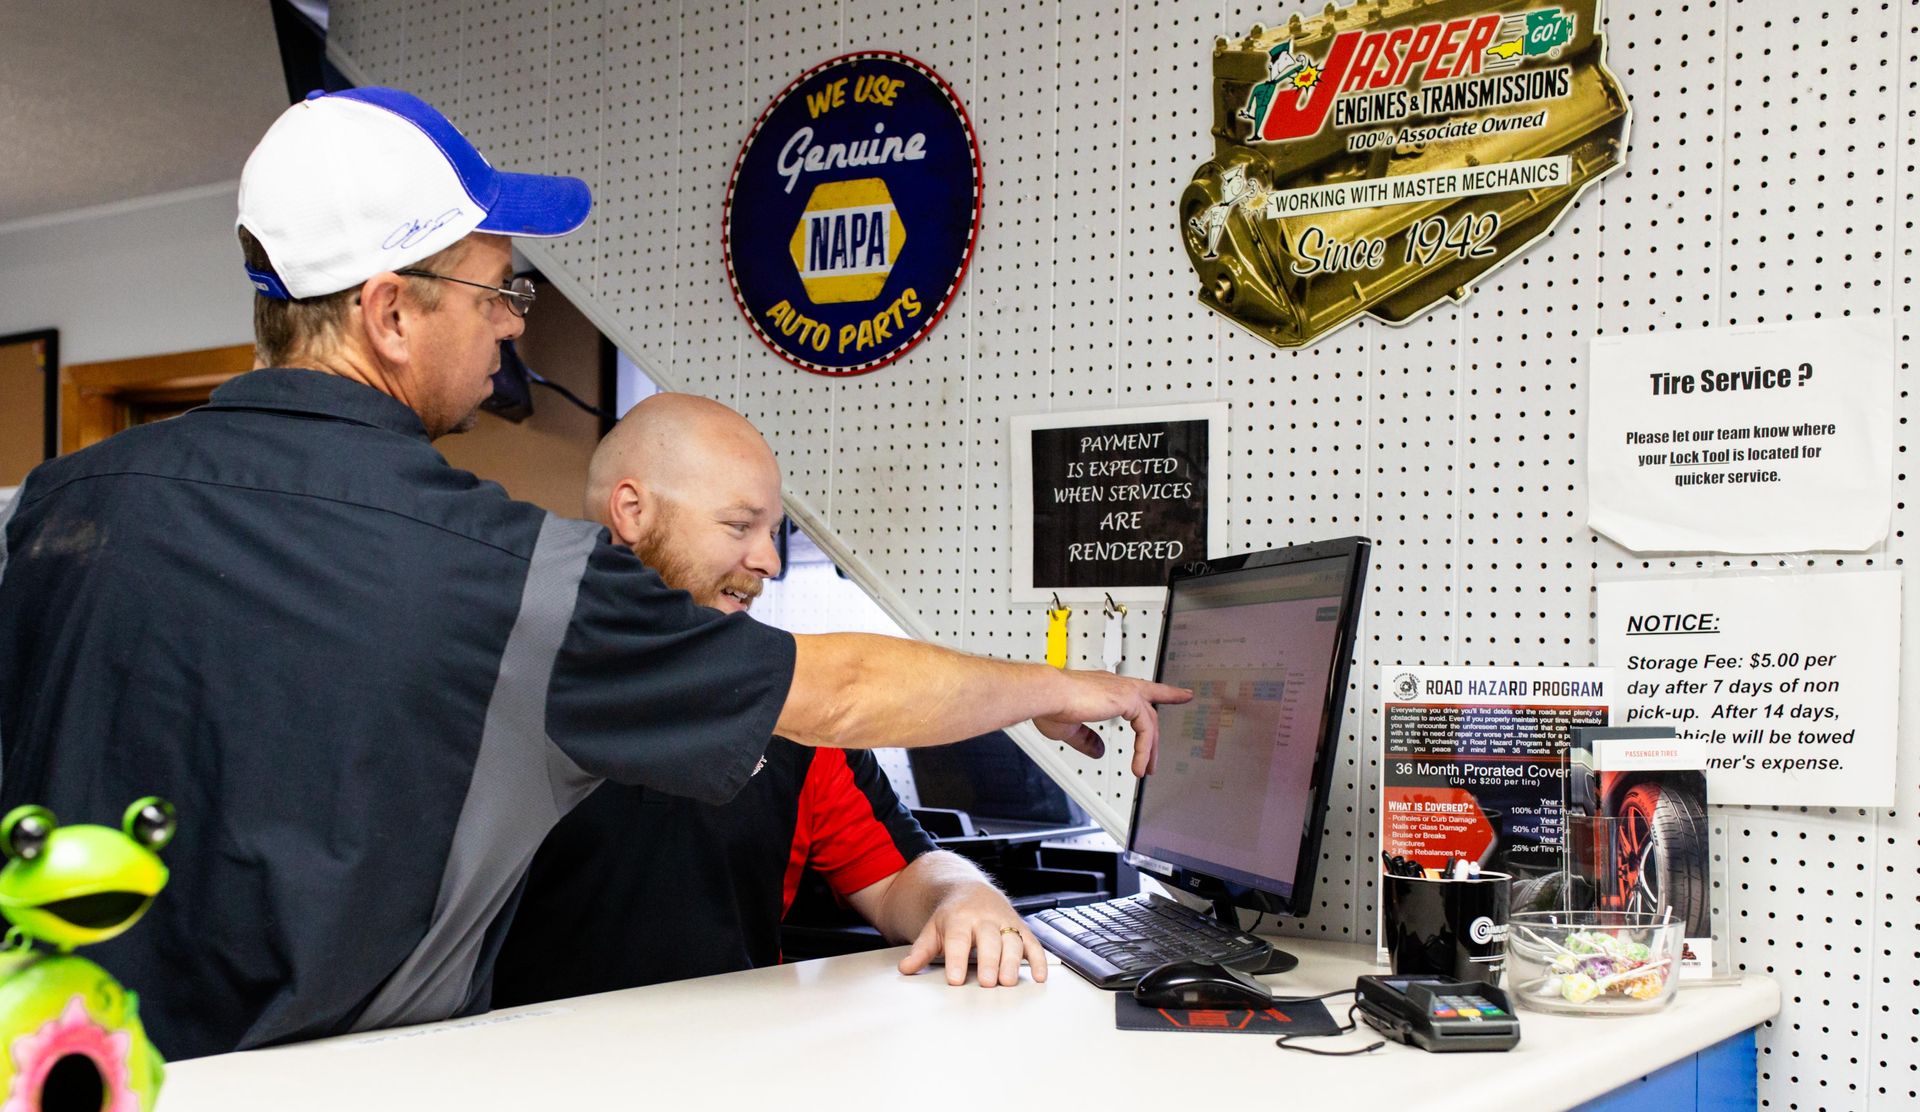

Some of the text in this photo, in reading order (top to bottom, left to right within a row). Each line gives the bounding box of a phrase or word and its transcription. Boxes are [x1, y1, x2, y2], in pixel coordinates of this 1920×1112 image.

[1531, 22, 1560, 43] GO!
[1262, 14, 1500, 140] JASPER
[807, 74, 905, 119] WE USE
[1335, 68, 1569, 126] ENGINES & TRANSMISSIONS
[1348, 111, 1545, 150] 100% Associate Owned
[776, 122, 926, 194] Genuine
[1276, 162, 1559, 212] WORKING WITH MASTER MECHANICS
[809, 211, 885, 271] NAPA
[1291, 213, 1498, 275] Since 1942
[766, 287, 922, 353] AUTO PARTS
[1650, 362, 1813, 396] Tire Service ?
[1080, 432, 1164, 453] PAYMENT
[1626, 423, 1836, 444] Please let our team know where
[1638, 445, 1822, 467] your Lock Tool is located for
[1067, 457, 1178, 478] IS EXPECTED
[1675, 469, 1781, 487] quicker service.
[1054, 482, 1192, 504] WHEN SERVICES
[1100, 511, 1143, 531] ARE
[1068, 540, 1183, 562] RENDERED
[1627, 613, 1720, 634] NOTICE:
[1627, 652, 1837, 673] Storage Fee: $5.00 per
[1426, 680, 1463, 695] ROAD
[1468, 681, 1527, 696] HAZARD
[1533, 681, 1603, 697] PROGRAM
[1627, 678, 1839, 698] day after 7 days of non
[1572, 717, 1602, 725] inevitably
[1573, 709, 1592, 717] plenty
[1627, 703, 1839, 722] pick-up. After 14 days,
[1425, 738, 1459, 746] Purchasing
[1675, 729, 1855, 744] hicle will be towed
[1396, 763, 1571, 778] 36 Month Prorated Cover
[1706, 755, 1844, 773] ner's expense.
[1450, 777, 1465, 785] (Up
[1522, 778, 1540, 787] tire)
[1511, 807, 1532, 815] 100%
[1534, 807, 1541, 815] of
[1540, 798, 1558, 806] Year
[1540, 845, 1555, 853] Tire
